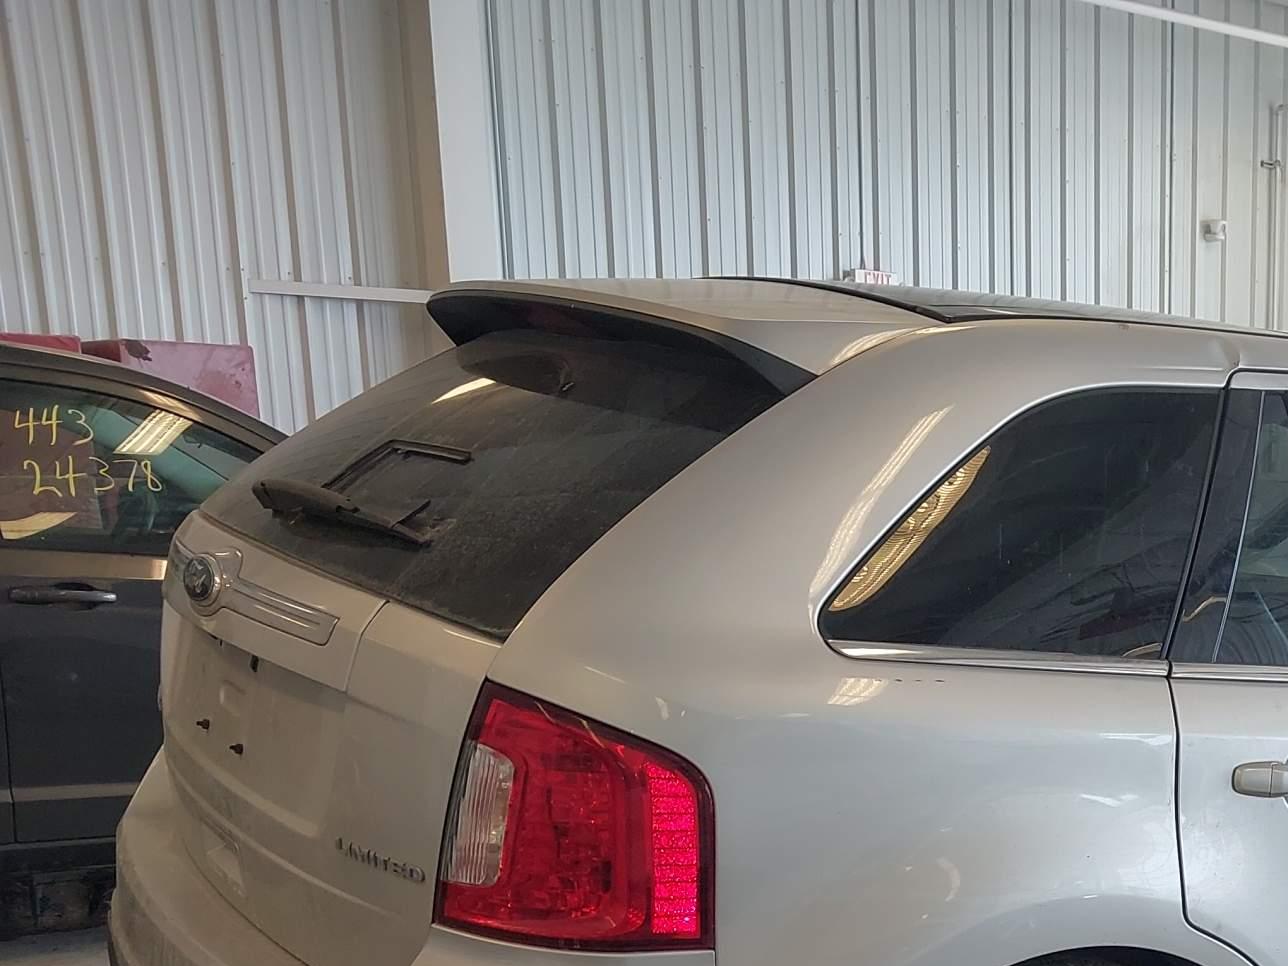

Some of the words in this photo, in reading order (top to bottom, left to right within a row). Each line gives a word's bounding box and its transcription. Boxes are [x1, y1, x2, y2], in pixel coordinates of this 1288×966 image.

[14, 404, 94, 445] 443
[23, 455, 163, 497] 24378
[335, 837, 426, 882] LIMITED
